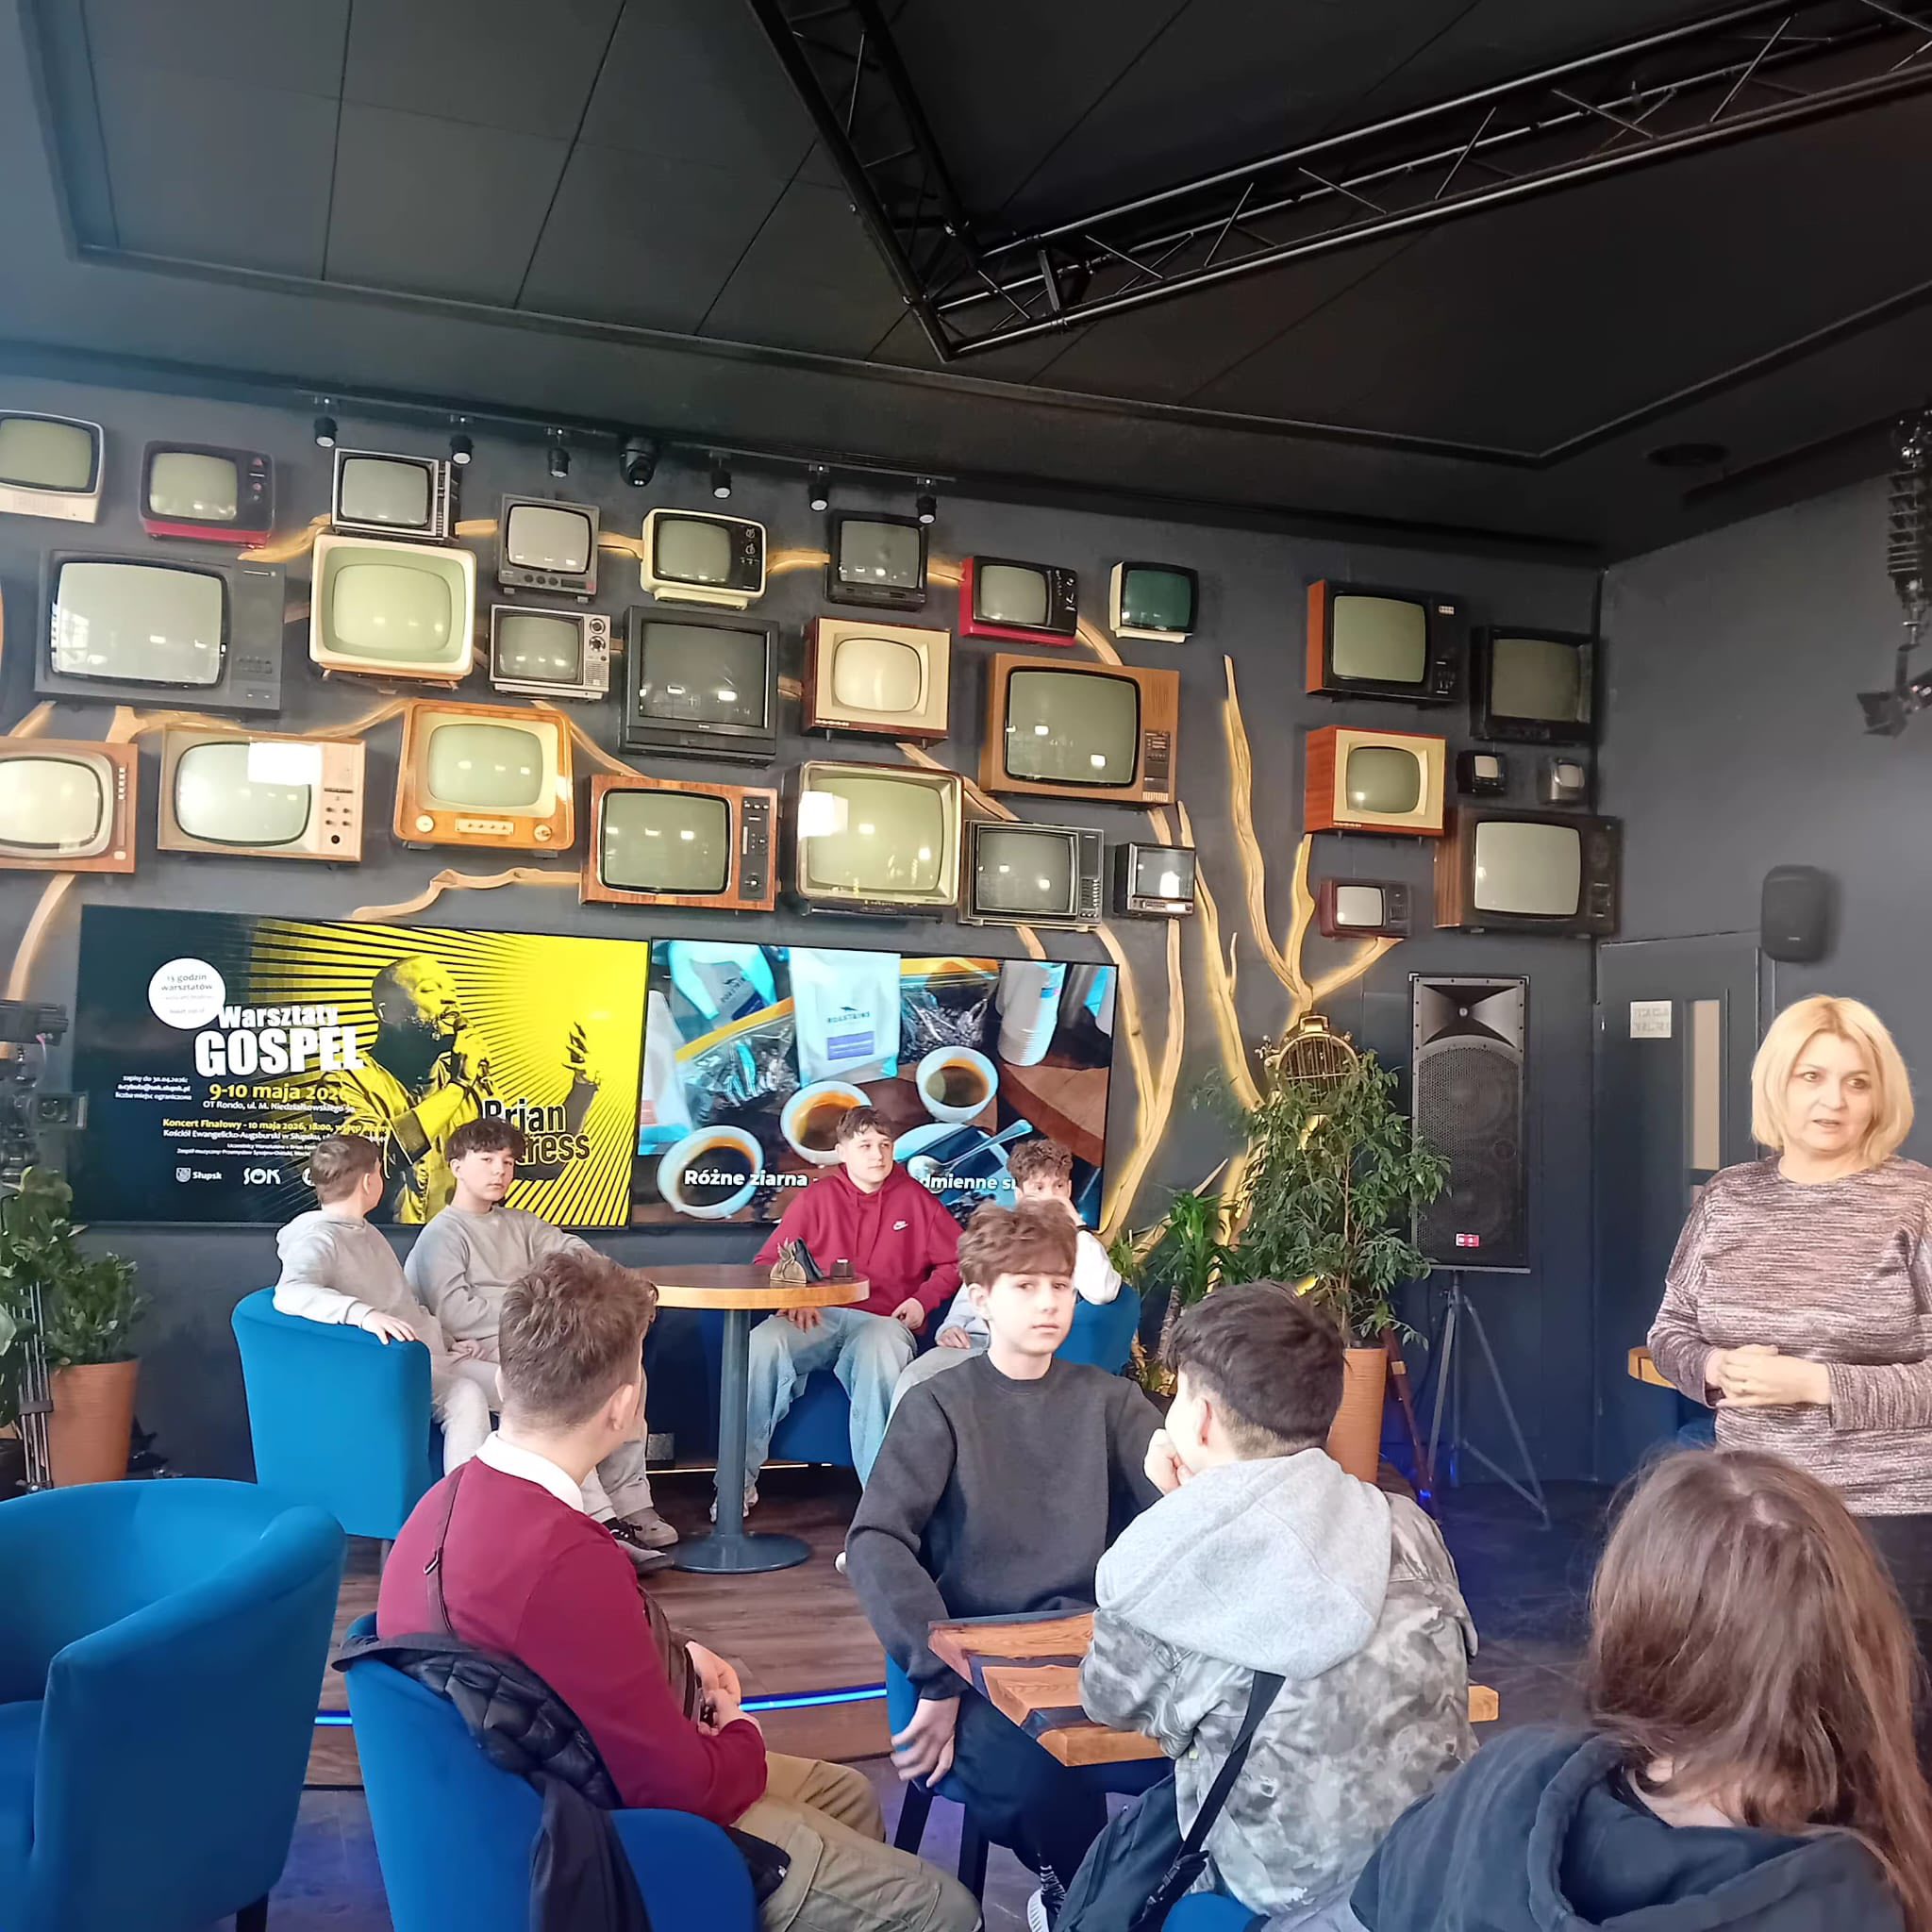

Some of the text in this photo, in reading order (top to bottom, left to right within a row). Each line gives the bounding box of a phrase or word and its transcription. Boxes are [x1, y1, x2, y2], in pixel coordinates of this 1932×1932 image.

[177, 974, 207, 983] godzin
[220, 1005, 339, 1029] Warsztaty
[194, 1026, 365, 1078] GOSPEL
[209, 1083, 248, 1101] 9-10
[252, 1083, 301, 1103] maja
[203, 1100, 215, 1108] OT
[216, 1101, 246, 1110] Rondo,
[162, 1119, 199, 1128] Koncert
[201, 1120, 242, 1130] Finałowy
[259, 1122, 281, 1131] maja
[283, 1123, 308, 1132] 2026,
[192, 1167, 281, 1185] Słupsk SOK
[684, 1169, 745, 1186] Różne
[750, 1170, 808, 1187] ziarna
[920, 1173, 998, 1190] dmienne
